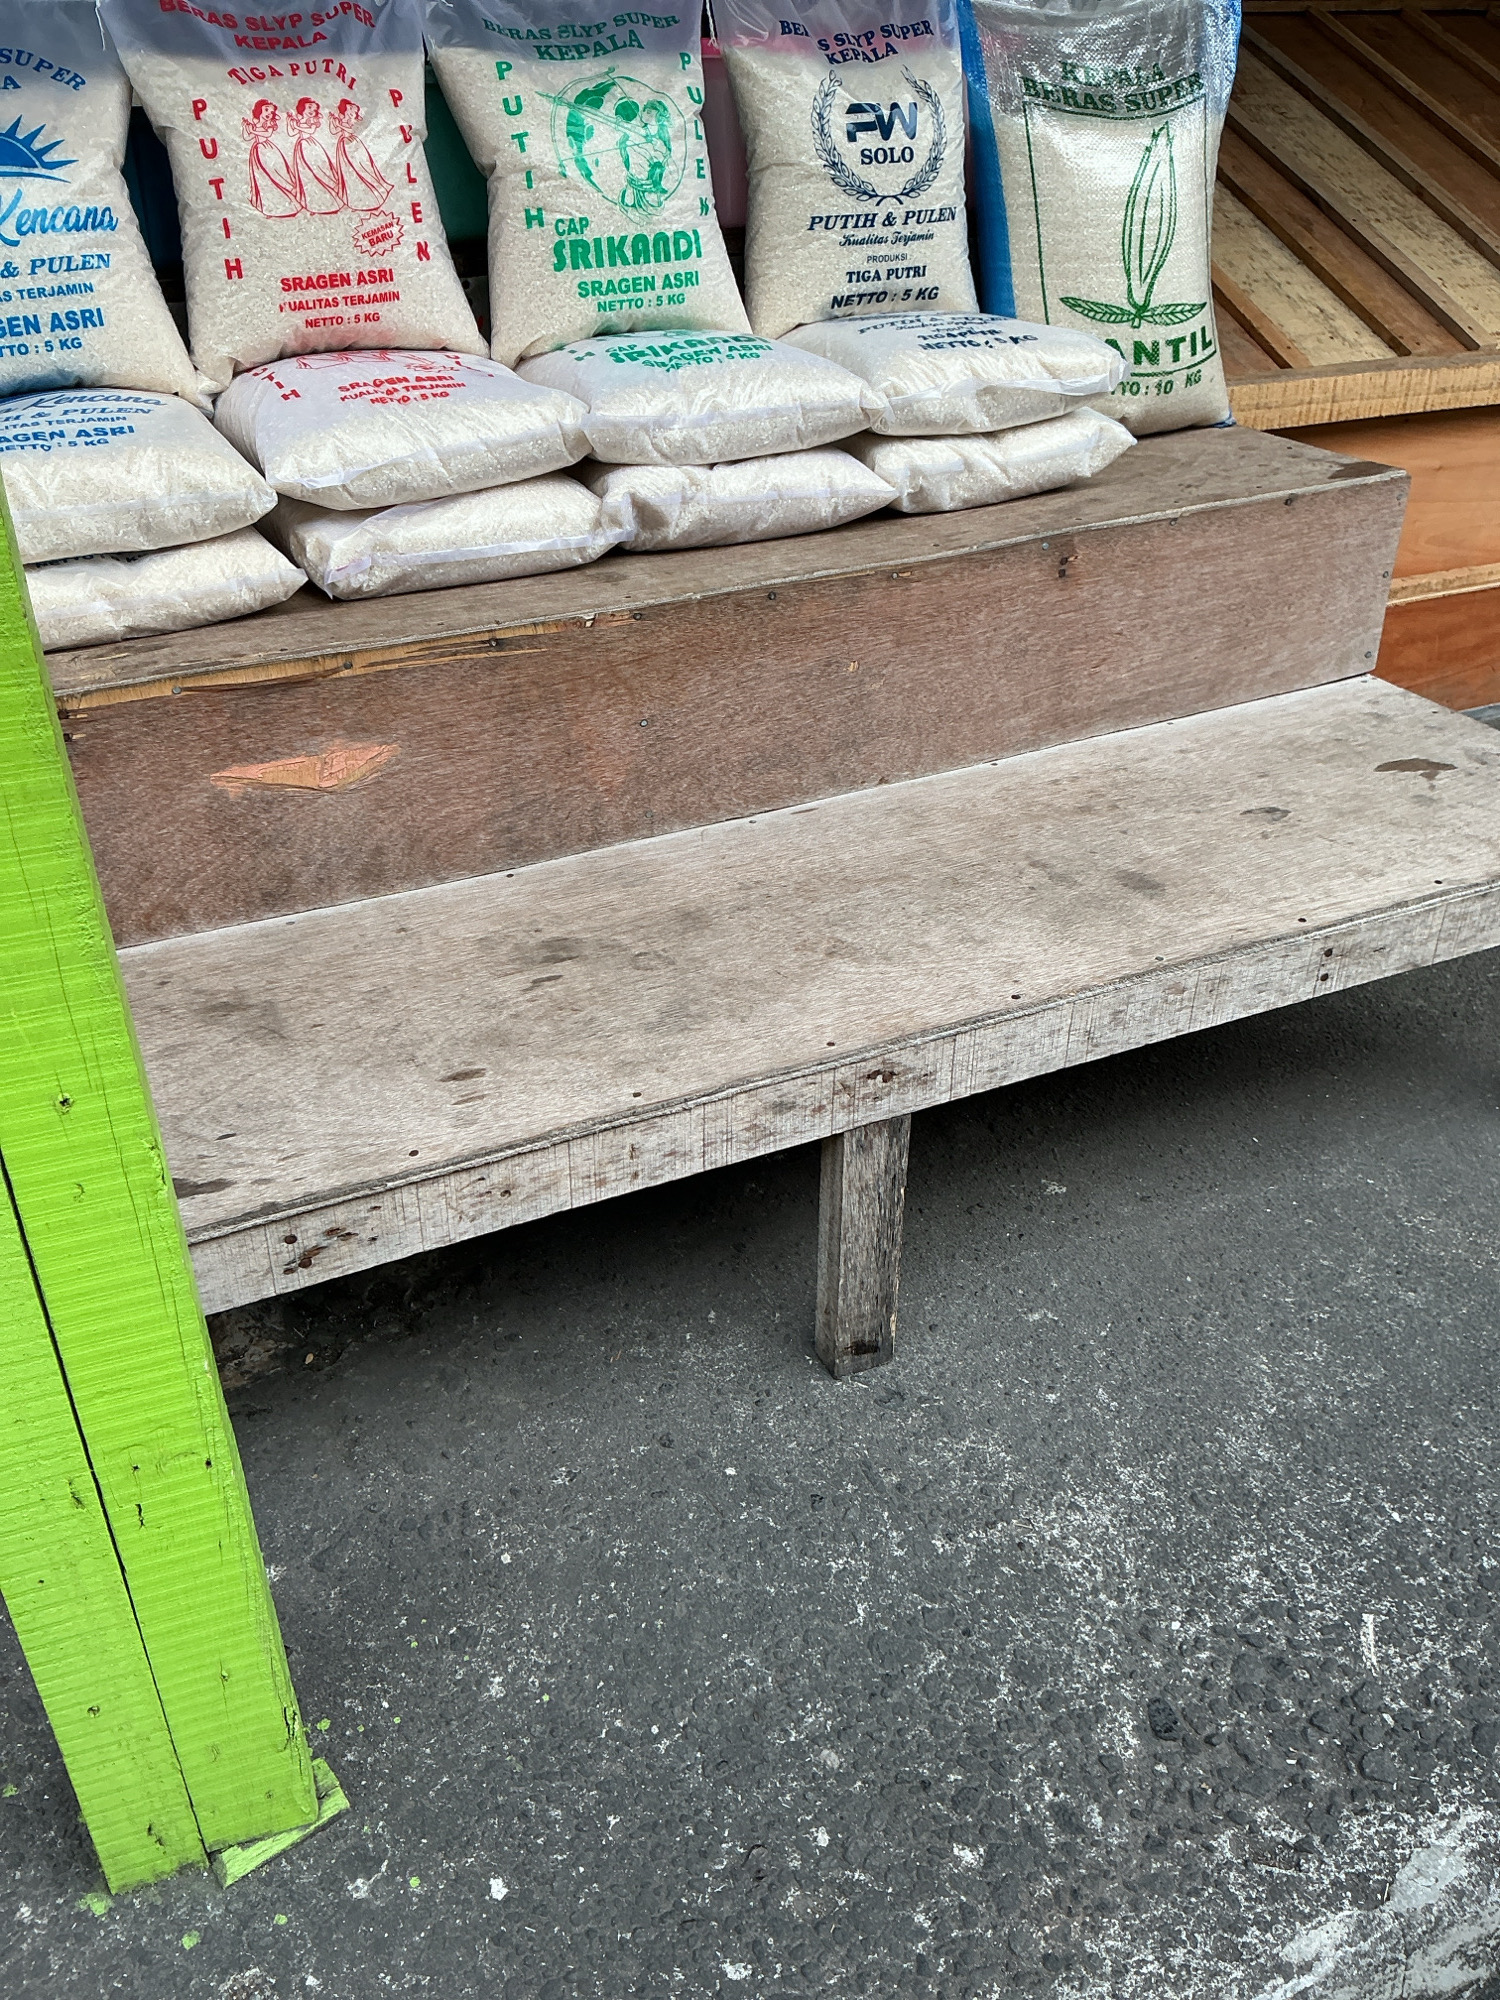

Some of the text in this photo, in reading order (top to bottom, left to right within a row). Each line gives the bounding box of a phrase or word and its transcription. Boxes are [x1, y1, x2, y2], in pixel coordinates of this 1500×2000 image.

[159, 0, 375, 32] BERAS SLYP SUPER
[481, 18, 551, 41] BERAS
[613, 12, 681, 29] SUPER
[880, 20, 935, 39] SUPER
[234, 31, 328, 50] KEPALA
[533, 29, 645, 61] KEPALA
[825, 42, 898, 65] KEPALA
[0, 48, 86, 91] SUPER
[227, 58, 357, 90] TIGA PUTRI
[1020, 71, 1205, 113] BERAS SUPER
[860, 147, 914, 165] SOLO
[554, 217, 590, 236] CAP
[807, 206, 957, 231] PUTIH & PULEN
[361, 221, 394, 239] KEMASAN
[368, 230, 394, 247] BARU
[839, 229, 935, 247] Kualitas Terjamin
[553, 228, 702, 272] SRIKANDI
[867, 253, 908, 264] PRODUKSI
[28, 253, 111, 276] PULEN
[846, 265, 927, 283] TIGA PUTRI
[281, 268, 394, 292] SRAGEN ASRI
[577, 271, 699, 298] SRAGEN ASRI
[17, 282, 94, 300] TERJAMIN
[342, 291, 400, 307] TERJAMIN
[831, 290, 889, 309] NETTO
[901, 289, 913, 301] 5
[915, 286, 939, 300] KG
[597, 298, 644, 312] NETTO
[656, 295, 664, 306] 5
[667, 293, 686, 305] KG
[50, 307, 105, 332] ASRI
[305, 315, 344, 328] NETTO
[354, 314, 361, 324] 5
[364, 313, 380, 323] KG
[44, 340, 54, 352] 5
[59, 337, 82, 350] KG
[727, 344, 773, 352] ASRI
[738, 352, 760, 360] KG
[402, 382, 467, 392] TERJAMIN
[1184, 369, 1202, 388] KG
[45, 416, 127, 426] TERJAMIN
[60, 407, 154, 416] PULEN
[76, 425, 135, 438] ASRI
[84, 438, 109, 446] KG
